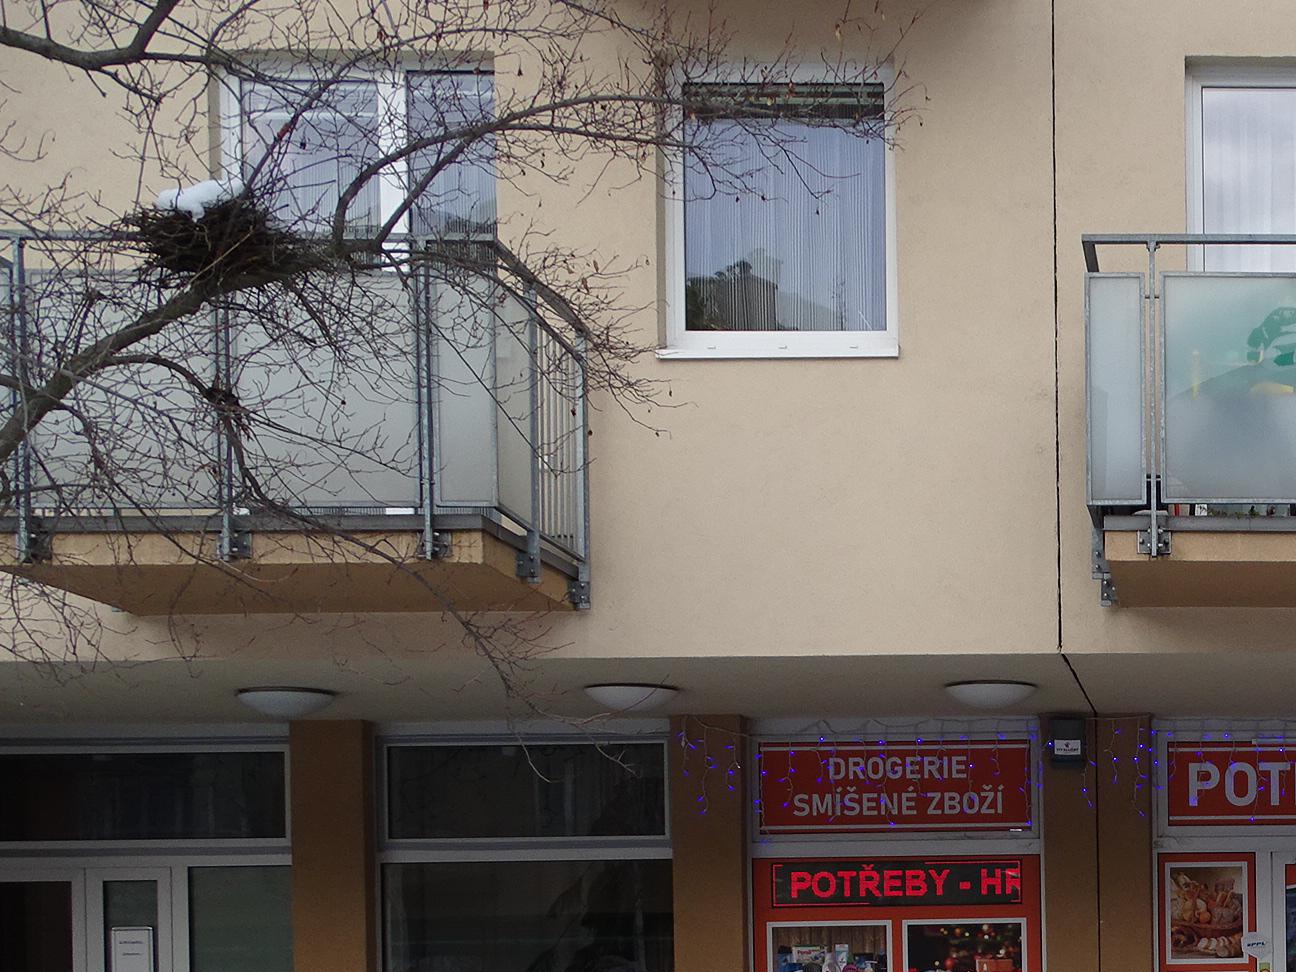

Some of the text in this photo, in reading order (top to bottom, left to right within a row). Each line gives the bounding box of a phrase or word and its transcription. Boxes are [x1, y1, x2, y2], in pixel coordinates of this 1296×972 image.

[829, 755, 967, 780] DROGERIE
[793, 784, 1004, 817] SMÍŠENÉ ZBOŽÍ
[791, 864, 950, 898] POTŘEBY
